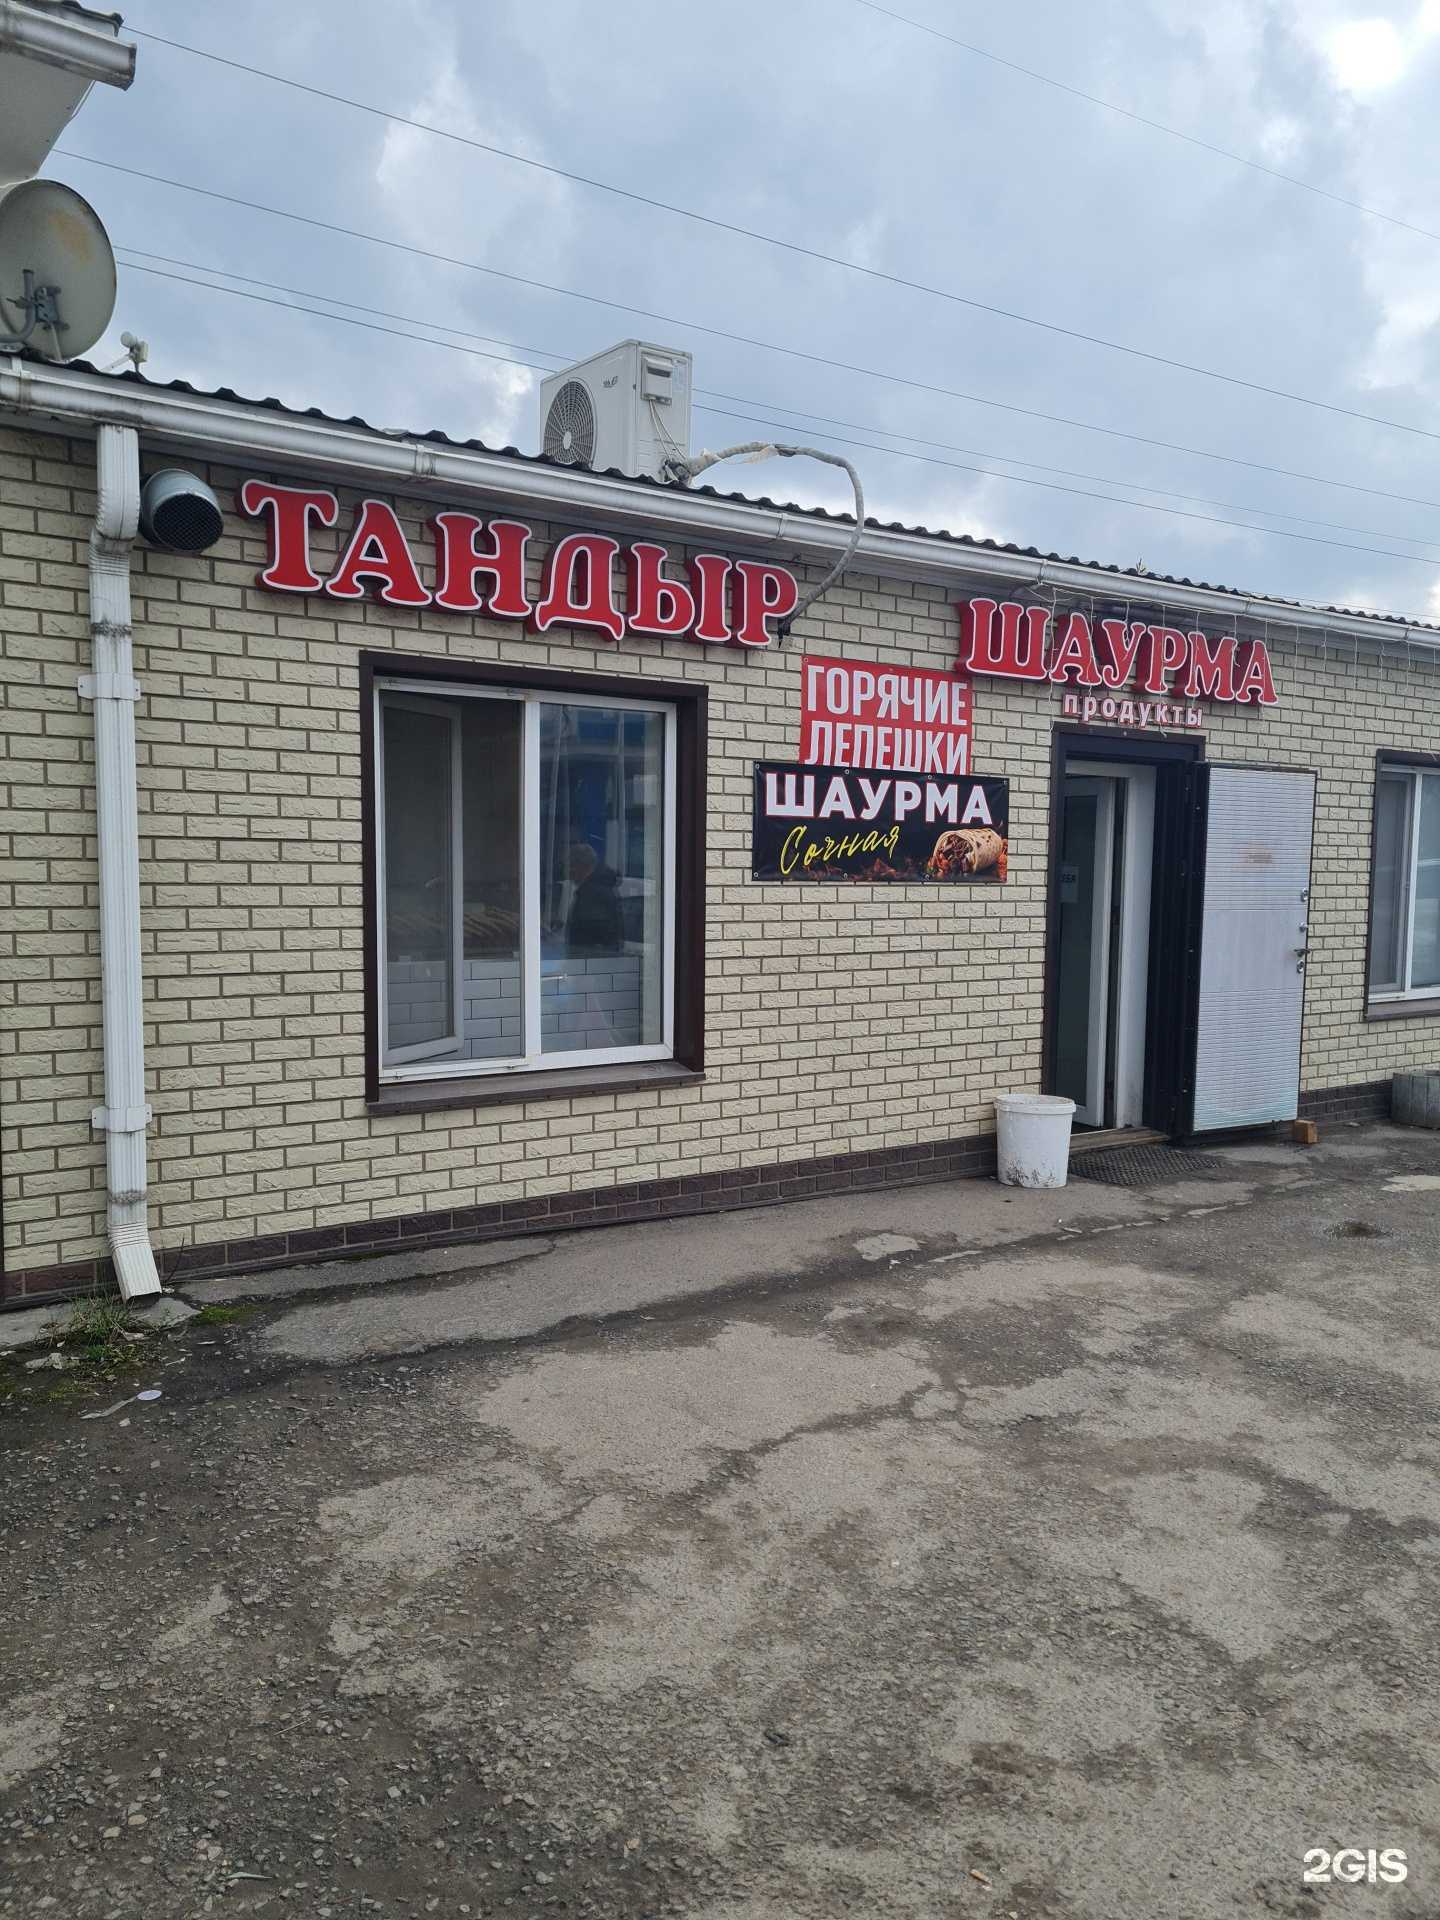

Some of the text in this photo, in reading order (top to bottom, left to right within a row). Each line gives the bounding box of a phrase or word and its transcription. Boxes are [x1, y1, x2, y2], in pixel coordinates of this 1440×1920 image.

[241, 479, 799, 646] ТАНДЫР
[965, 597, 1279, 705] ШАУРМА
[807, 664, 969, 727] ГОРЯЧИЕ
[1064, 693, 1203, 728] продукты
[804, 720, 969, 775] ЛЕПЕШКИ
[765, 772, 994, 825] ШАУРМА
[780, 825, 901, 875] Сочная
